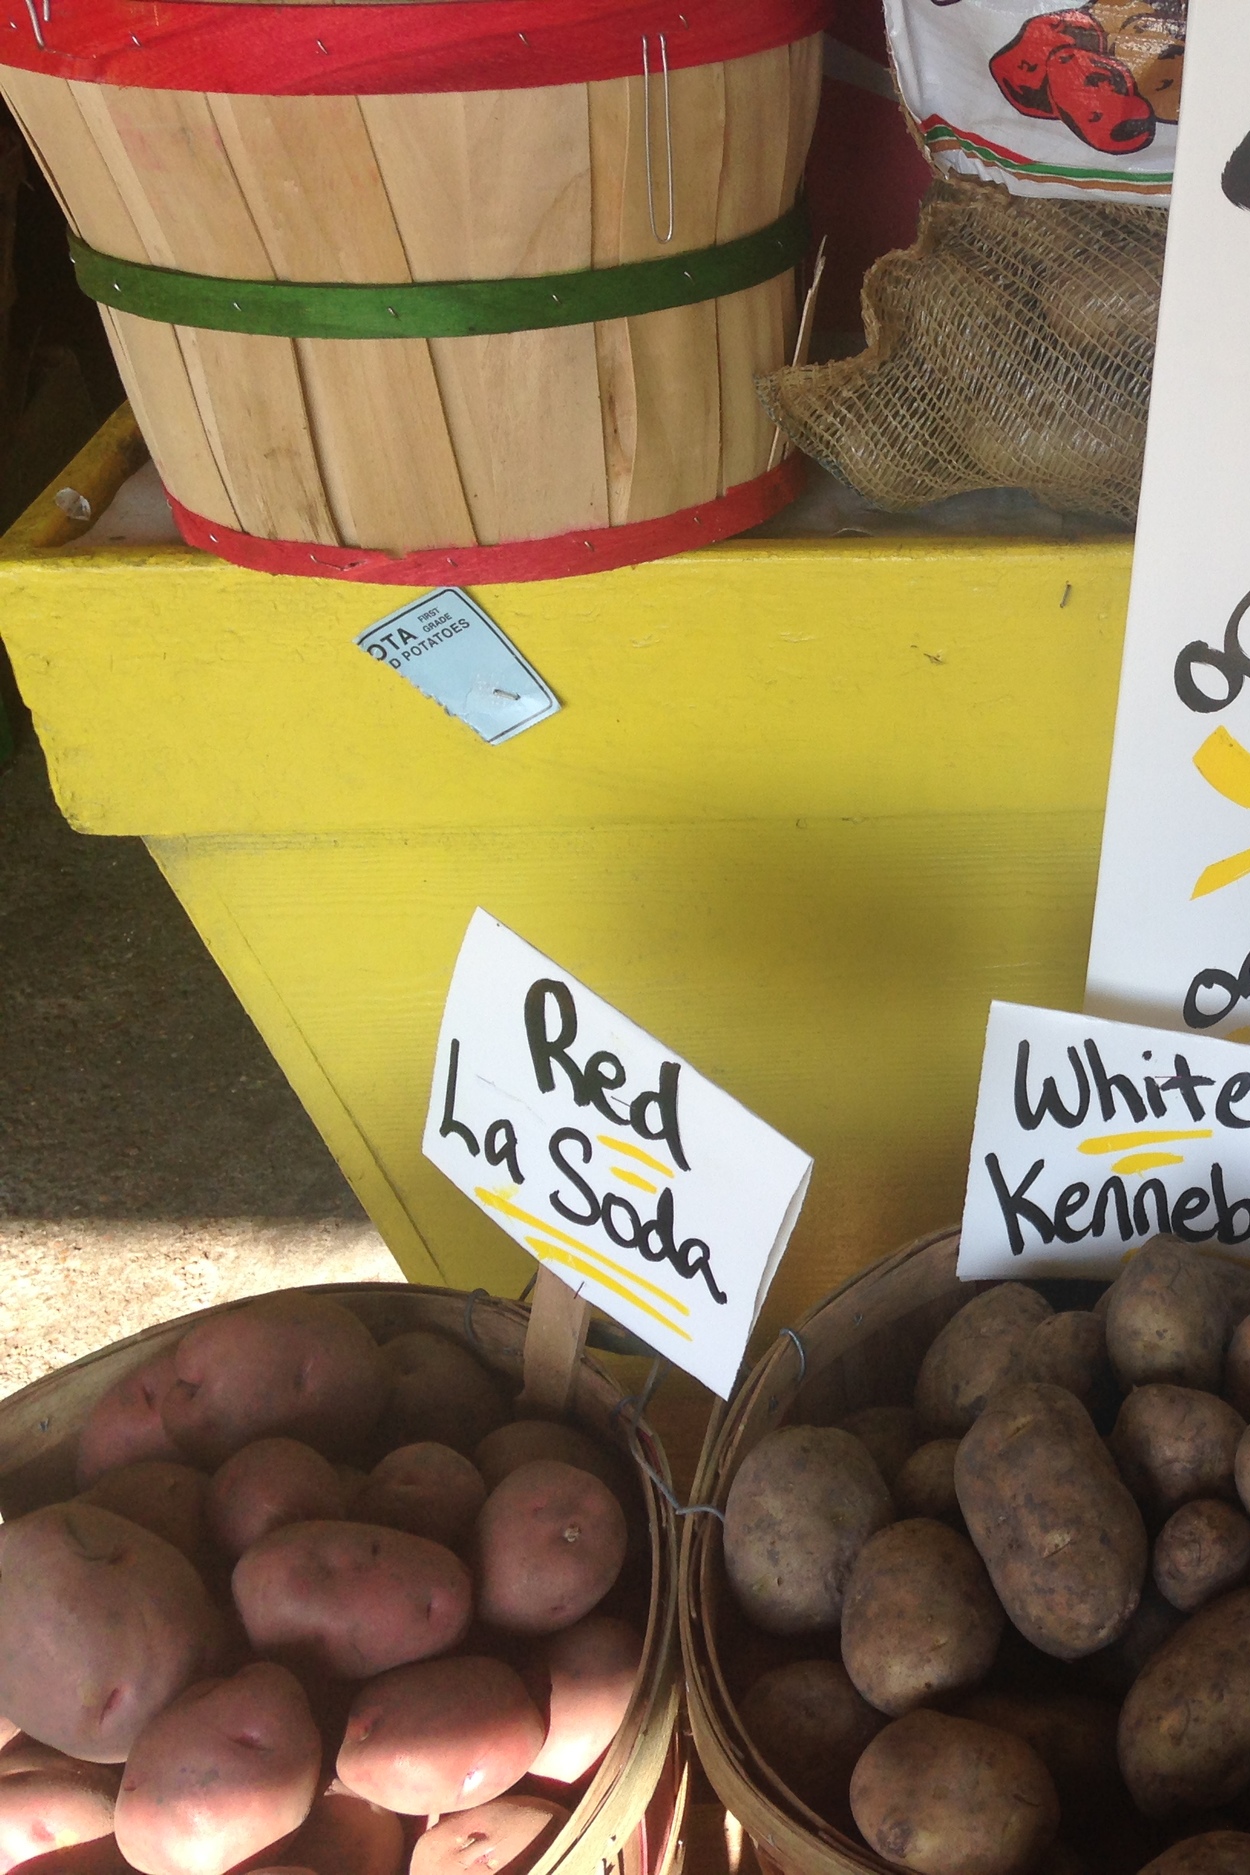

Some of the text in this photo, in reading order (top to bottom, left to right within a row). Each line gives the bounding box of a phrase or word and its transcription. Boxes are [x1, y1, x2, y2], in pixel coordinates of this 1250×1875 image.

[417, 606, 440, 623] FIRST
[422, 612, 453, 633] GRADE
[402, 618, 470, 661] POTATOES
[524, 978, 691, 1171] Red
[440, 1038, 727, 1304] La Soda
